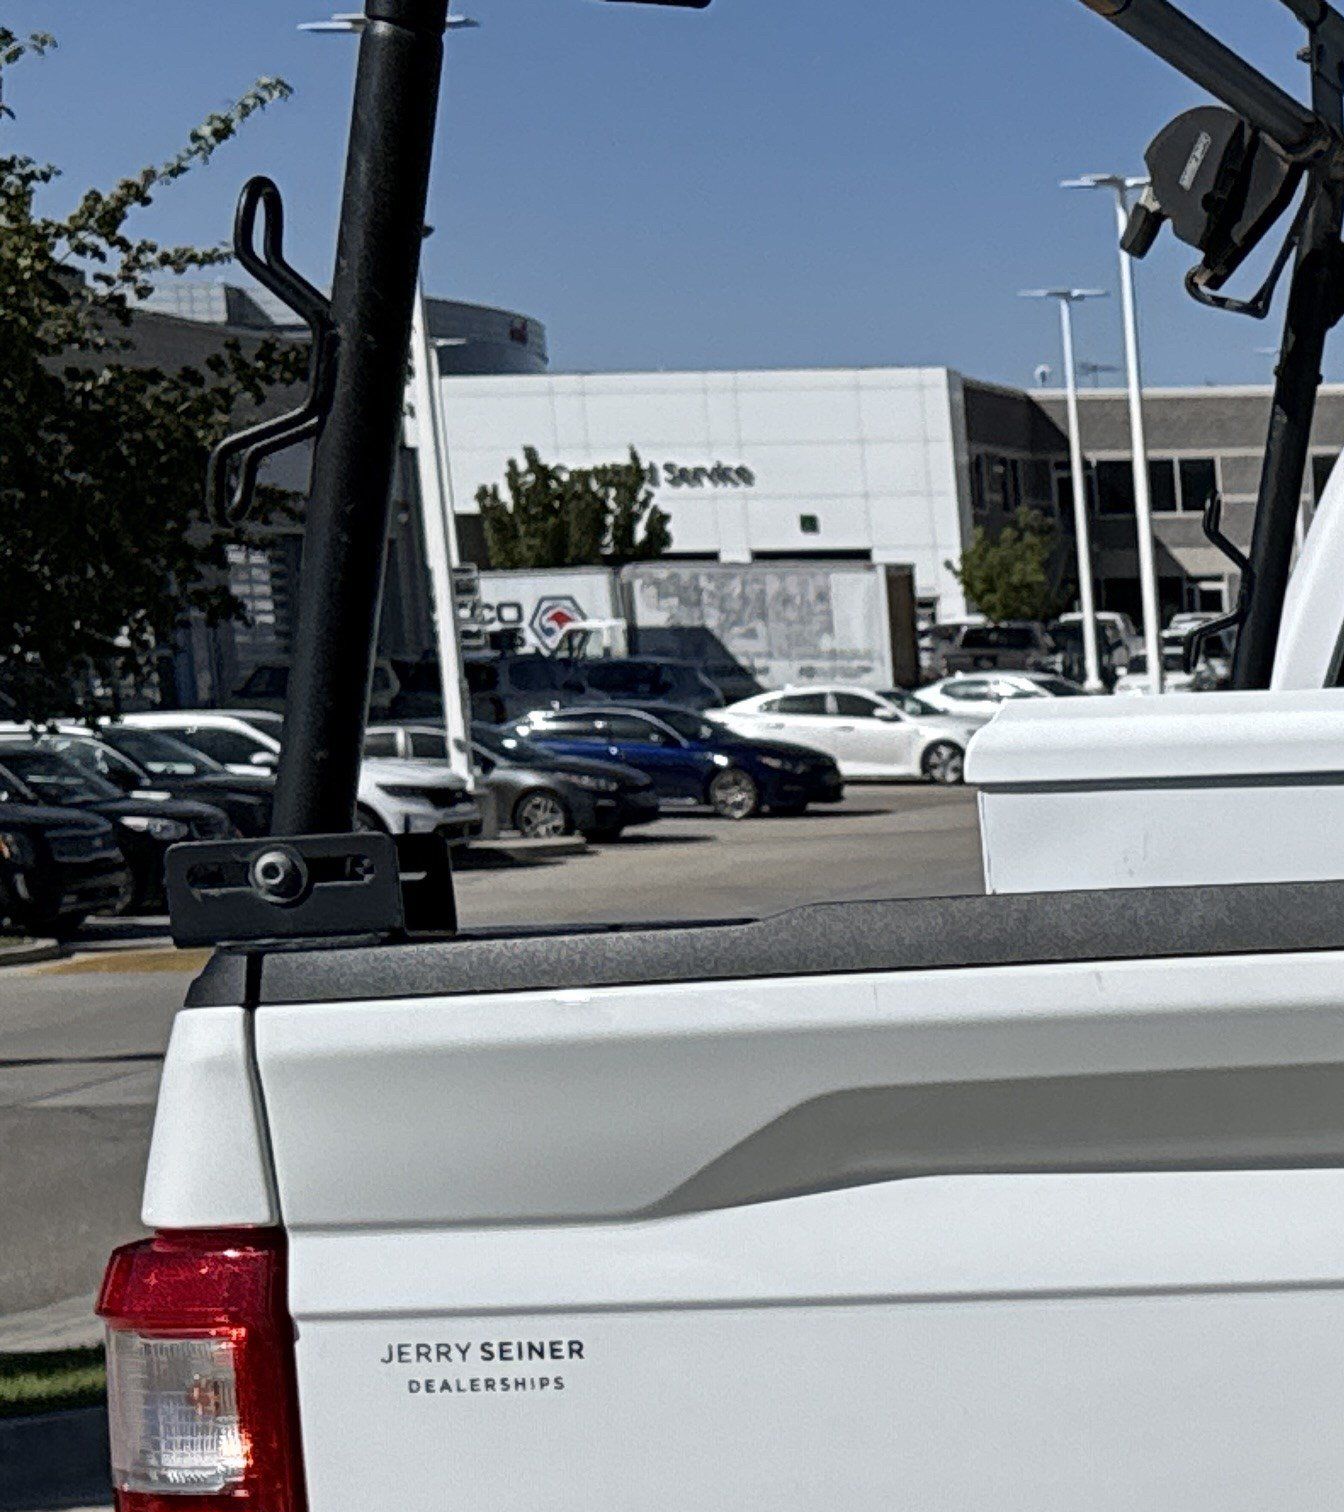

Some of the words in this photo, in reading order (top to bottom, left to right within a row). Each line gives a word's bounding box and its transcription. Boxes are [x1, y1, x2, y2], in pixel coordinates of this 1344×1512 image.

[662, 459, 756, 489] Service
[380, 1341, 473, 1364] JERRY
[479, 1339, 586, 1362] SEINER
[407, 1375, 566, 1395] DEALERSHIPS
